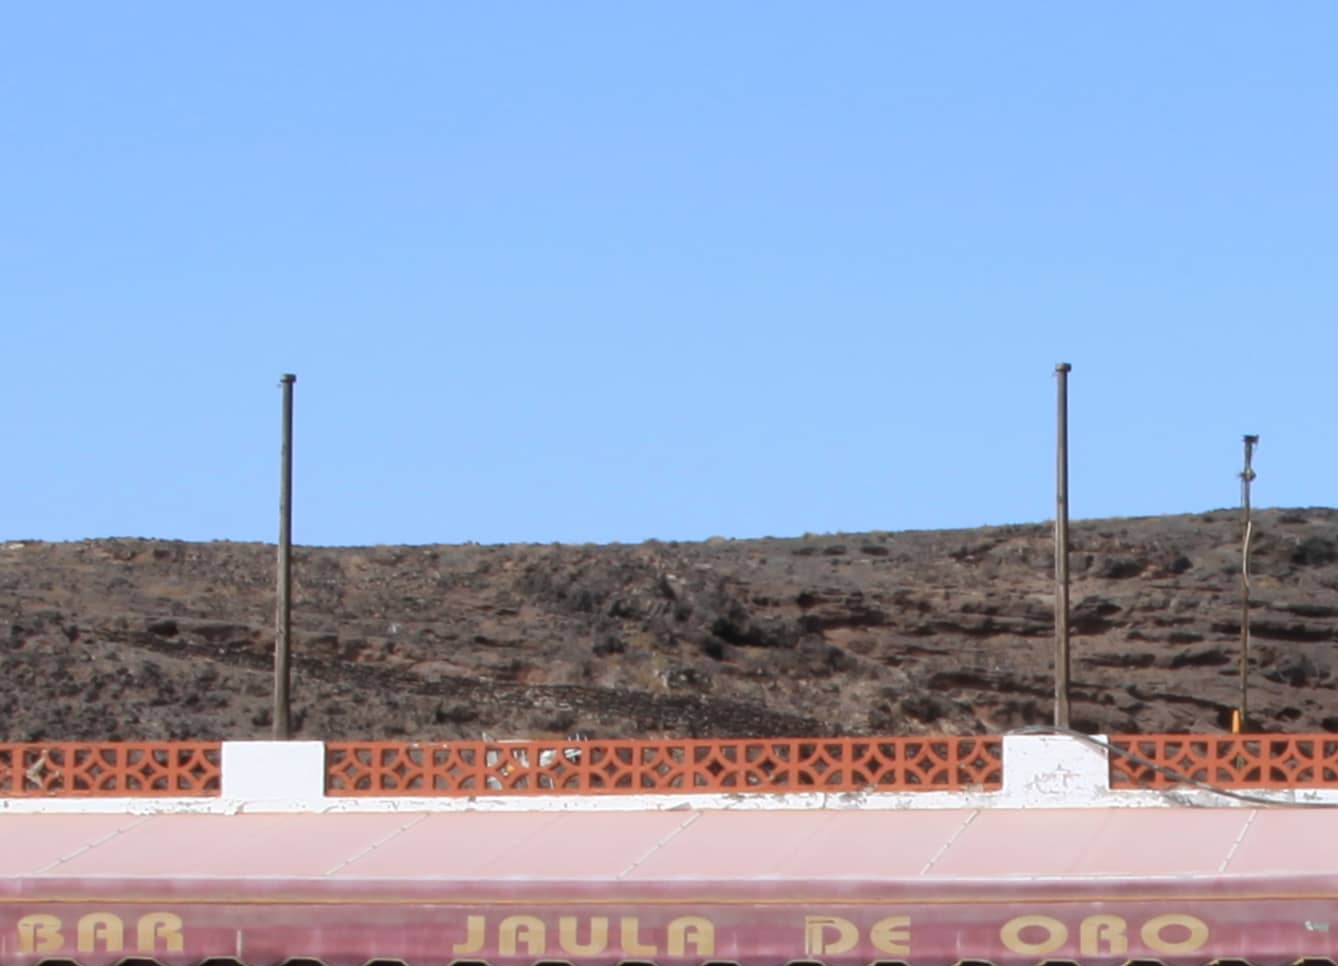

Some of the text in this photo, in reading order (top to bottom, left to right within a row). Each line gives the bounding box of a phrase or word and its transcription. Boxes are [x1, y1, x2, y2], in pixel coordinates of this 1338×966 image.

[17, 914, 1209, 956] BAR JAULA DE ORO
